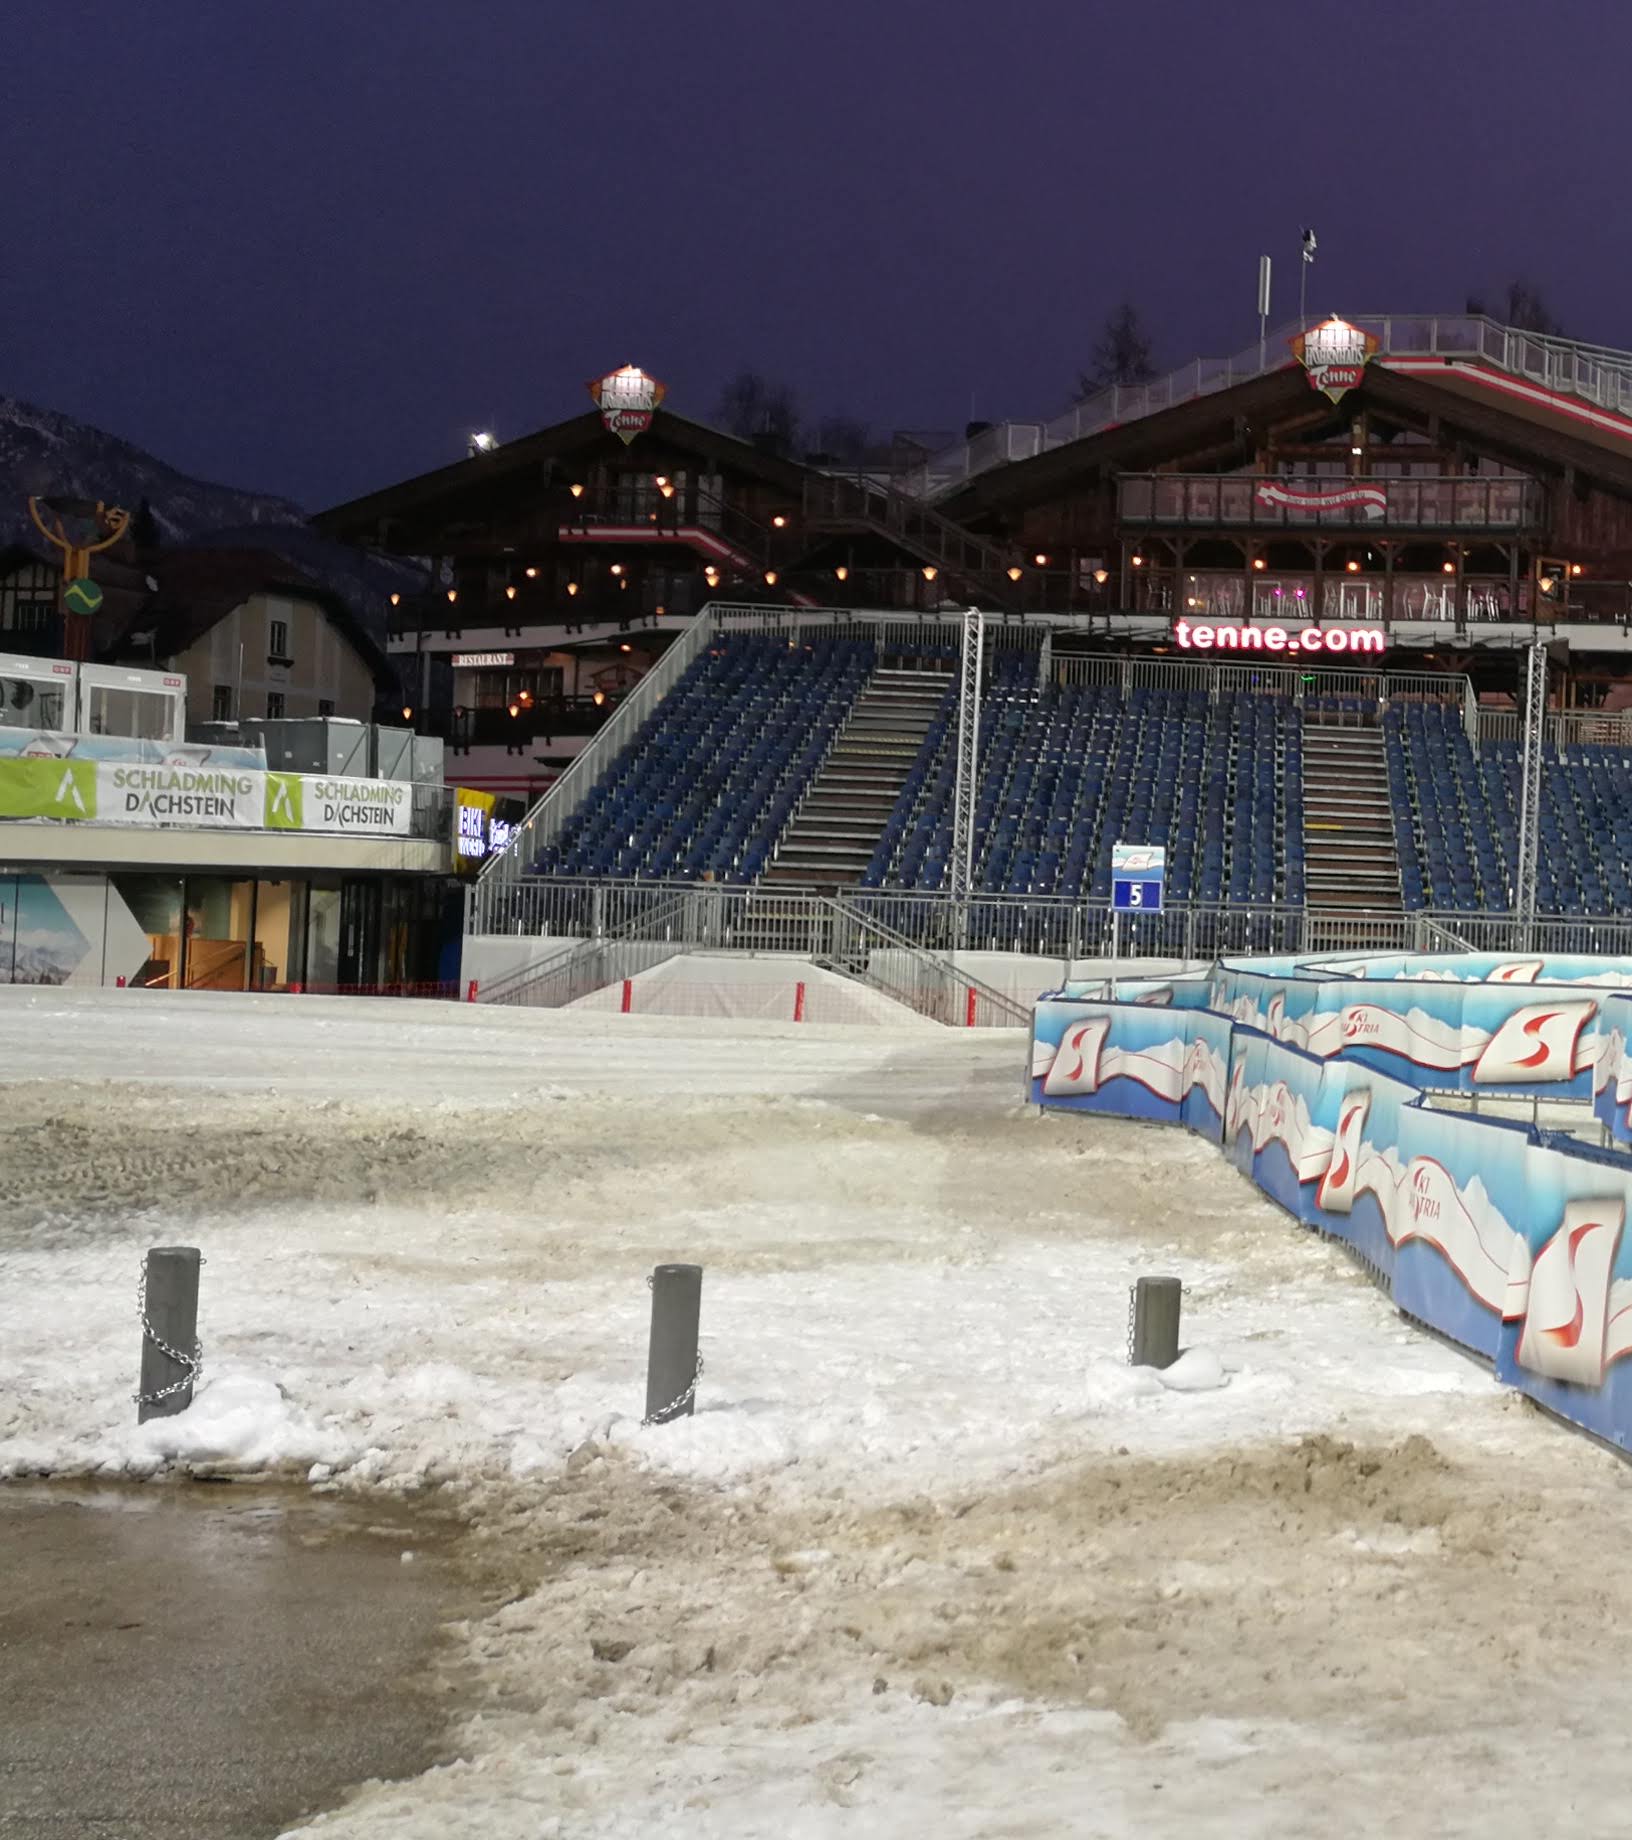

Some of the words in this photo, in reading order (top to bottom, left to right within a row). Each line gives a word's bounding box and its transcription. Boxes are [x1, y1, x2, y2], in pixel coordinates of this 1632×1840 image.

[1310, 366, 1357, 391] Tenne
[1175, 620, 1385, 652] tenne.com
[459, 653, 509, 667] RESTAURANT
[113, 768, 252, 796] SCHLADMING
[314, 782, 404, 805] SCHLADMING
[126, 792, 236, 820] DACHSTEIN
[324, 803, 395, 828] DACHSTEIN
[1130, 884, 1142, 906] 5
